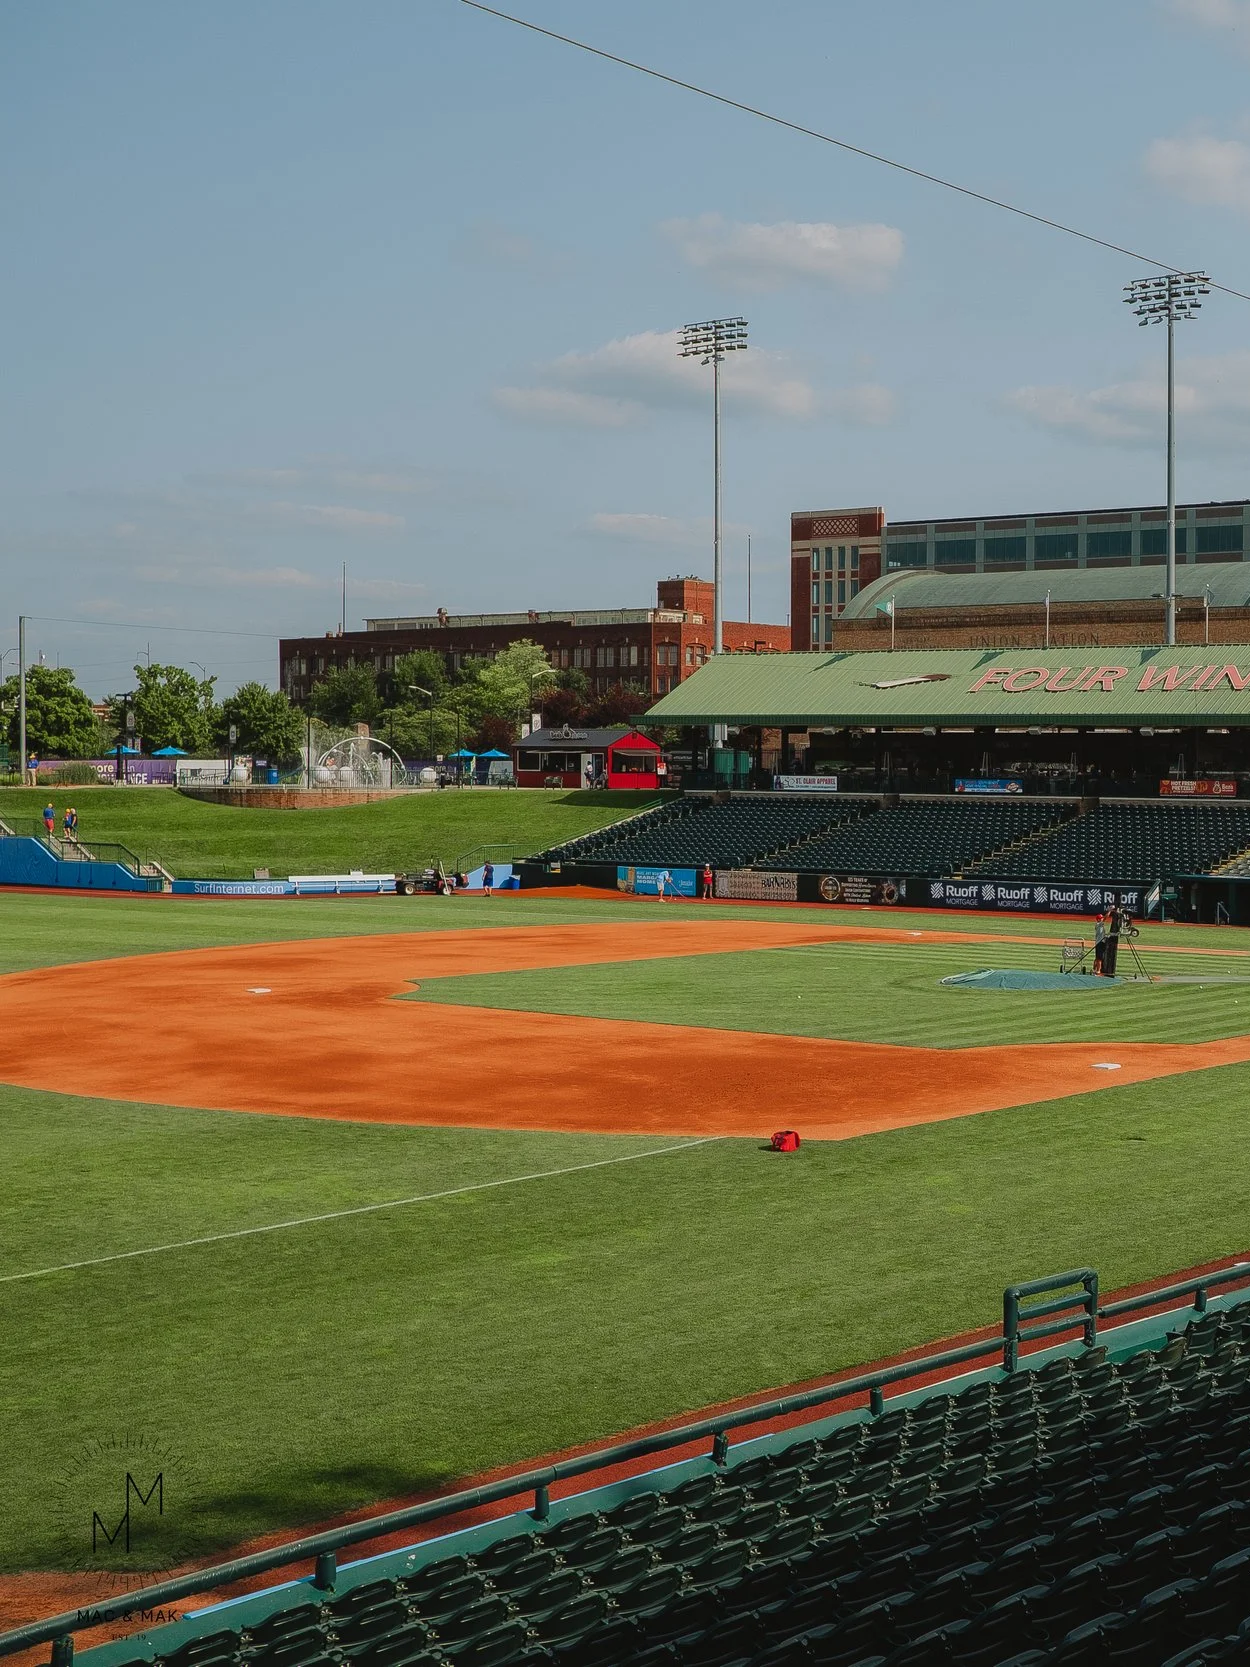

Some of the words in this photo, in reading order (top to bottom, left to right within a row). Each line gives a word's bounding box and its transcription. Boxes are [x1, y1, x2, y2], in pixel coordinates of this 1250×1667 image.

[970, 634, 1020, 648] UNION
[1033, 632, 1100, 647] STATION
[968, 666, 1129, 693] FOUR
[817, 777, 836, 785] APPAREL
[194, 883, 284, 894] SurfInternet.com
[946, 885, 978, 898] Ruoff
[997, 887, 1030, 900] Ruoff
[1050, 889, 1083, 902] Ruoff
[946, 898, 978, 906] MORTGAGE
[997, 900, 1030, 908] MORTGAGE
[1050, 902, 1083, 911] MORTGAGE
